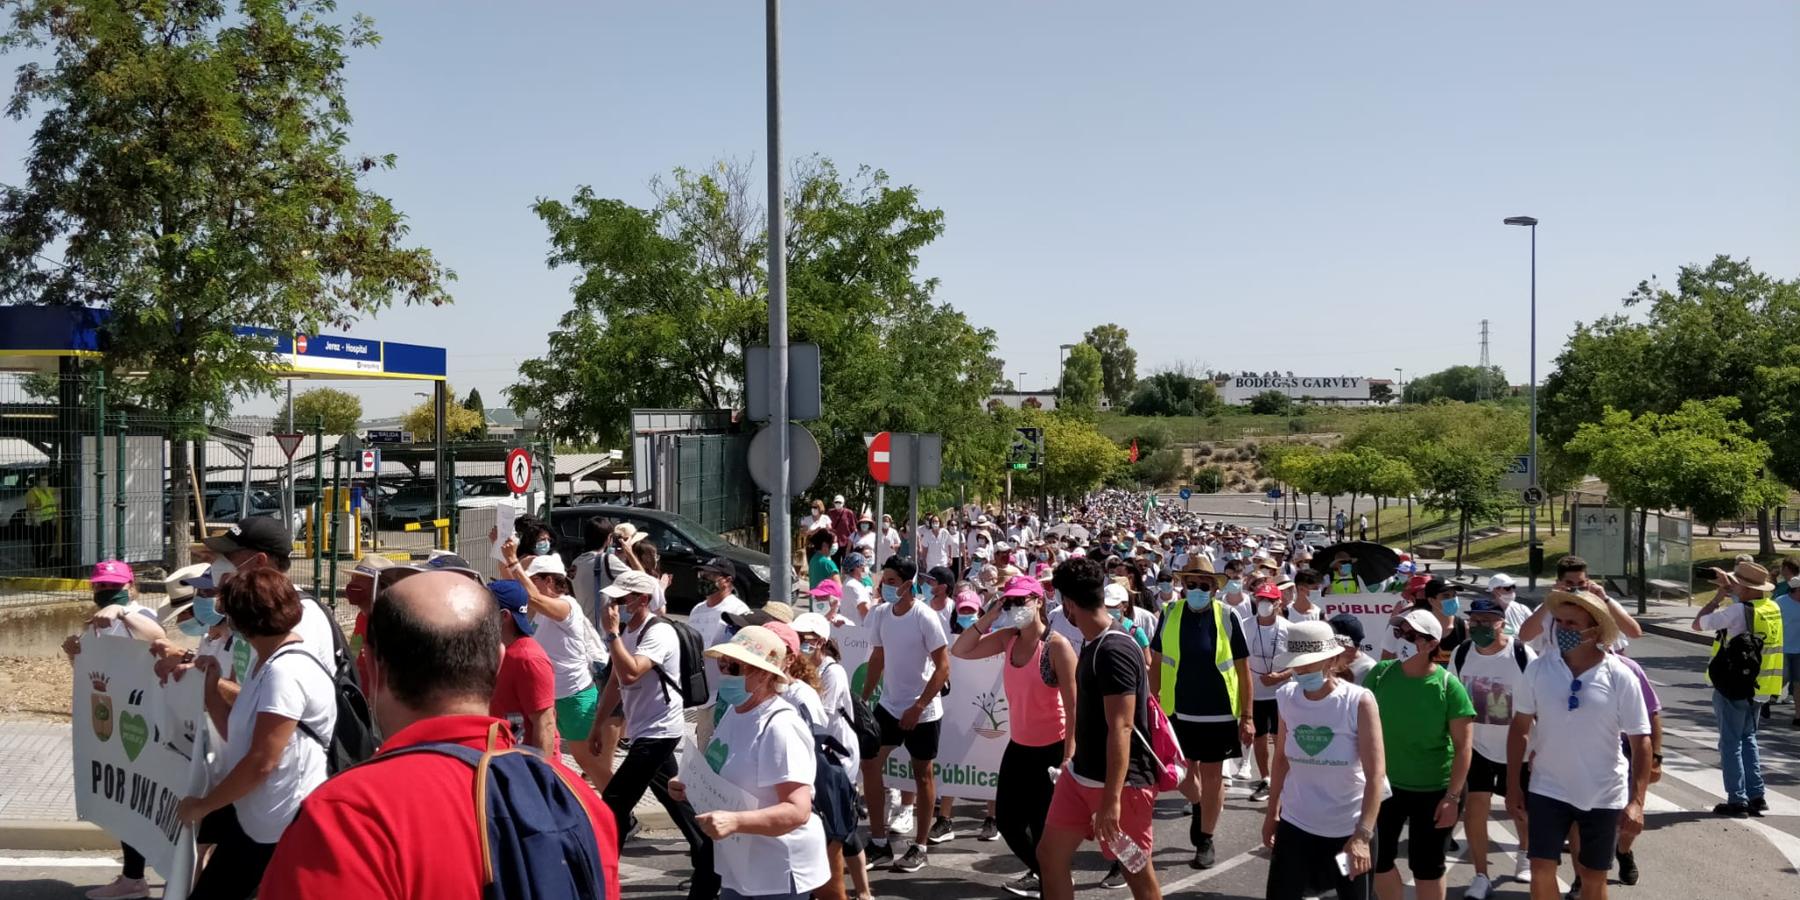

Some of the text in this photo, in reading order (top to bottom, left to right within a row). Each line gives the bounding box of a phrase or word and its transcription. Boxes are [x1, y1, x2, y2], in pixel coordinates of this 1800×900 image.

[345, 342, 368, 355] Hospital
[1236, 378, 1359, 388] BODEGAS GARVEY
[1326, 602, 1393, 614] PÚBLIC
[92, 760, 126, 804] POR
[130, 773, 157, 820] UNA
